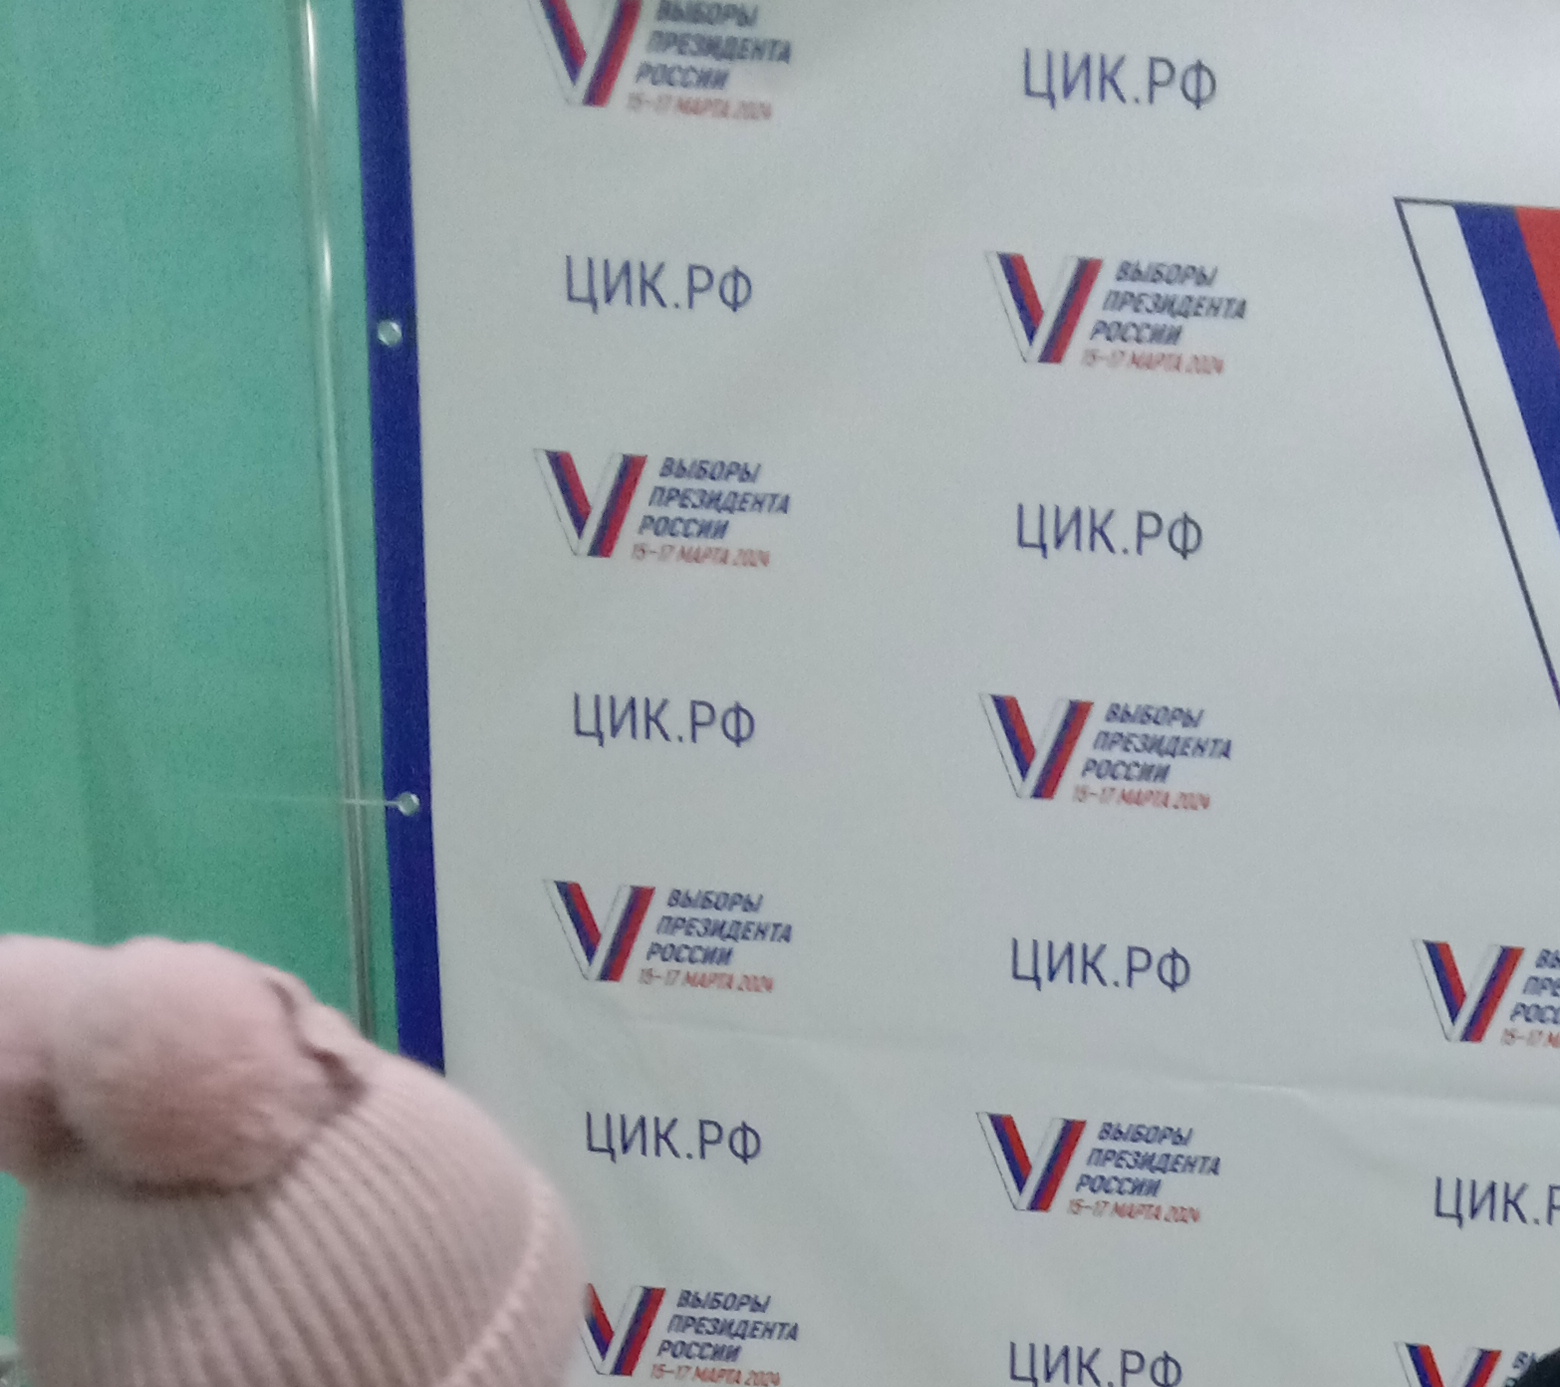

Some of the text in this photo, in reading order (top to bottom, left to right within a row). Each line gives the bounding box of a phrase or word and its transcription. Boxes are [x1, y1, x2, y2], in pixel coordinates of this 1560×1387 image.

[635, 61, 730, 90] РОССИИ
[1023, 48, 1217, 110] ЦИК.РФ
[566, 255, 752, 315] ЦИК.РФ
[1115, 259, 1218, 287] ВЫБОРЫ
[1102, 290, 1247, 319] ПРЕЗИДЕНТА
[1090, 320, 1183, 345] РОССИИ
[658, 456, 762, 483] ВЫБОРЫ
[648, 486, 791, 515] ПРЕЗИДЕНТА
[637, 515, 730, 540] РОССИИ
[1017, 503, 1203, 560] ЦИК.РФ
[573, 692, 755, 748] ЦИК.РФ
[1105, 703, 1205, 728] ВЫБОРЫ
[1092, 729, 1232, 760] ПРЕЗИДЕНТА
[1081, 758, 1171, 783] РОССИИ
[667, 888, 764, 913] ВЫБОРЫ
[656, 915, 793, 944] ПРЕЗИДЕНТА
[646, 941, 734, 965] РОССИИ
[1011, 937, 1191, 993] ЦИК.РФ
[586, 1111, 761, 1165] ЦИК.РФ
[1097, 1122, 1194, 1147] ВЫБОРЫ
[1086, 1148, 1221, 1176] ПРЕЗИДЕНТА
[1075, 1174, 1162, 1197] РОССИИ
[676, 1289, 772, 1313] ВЫБОРЫ
[667, 1314, 800, 1342] ПРЕЗИДЕНТА
[657, 1340, 742, 1362] РОССИИ
